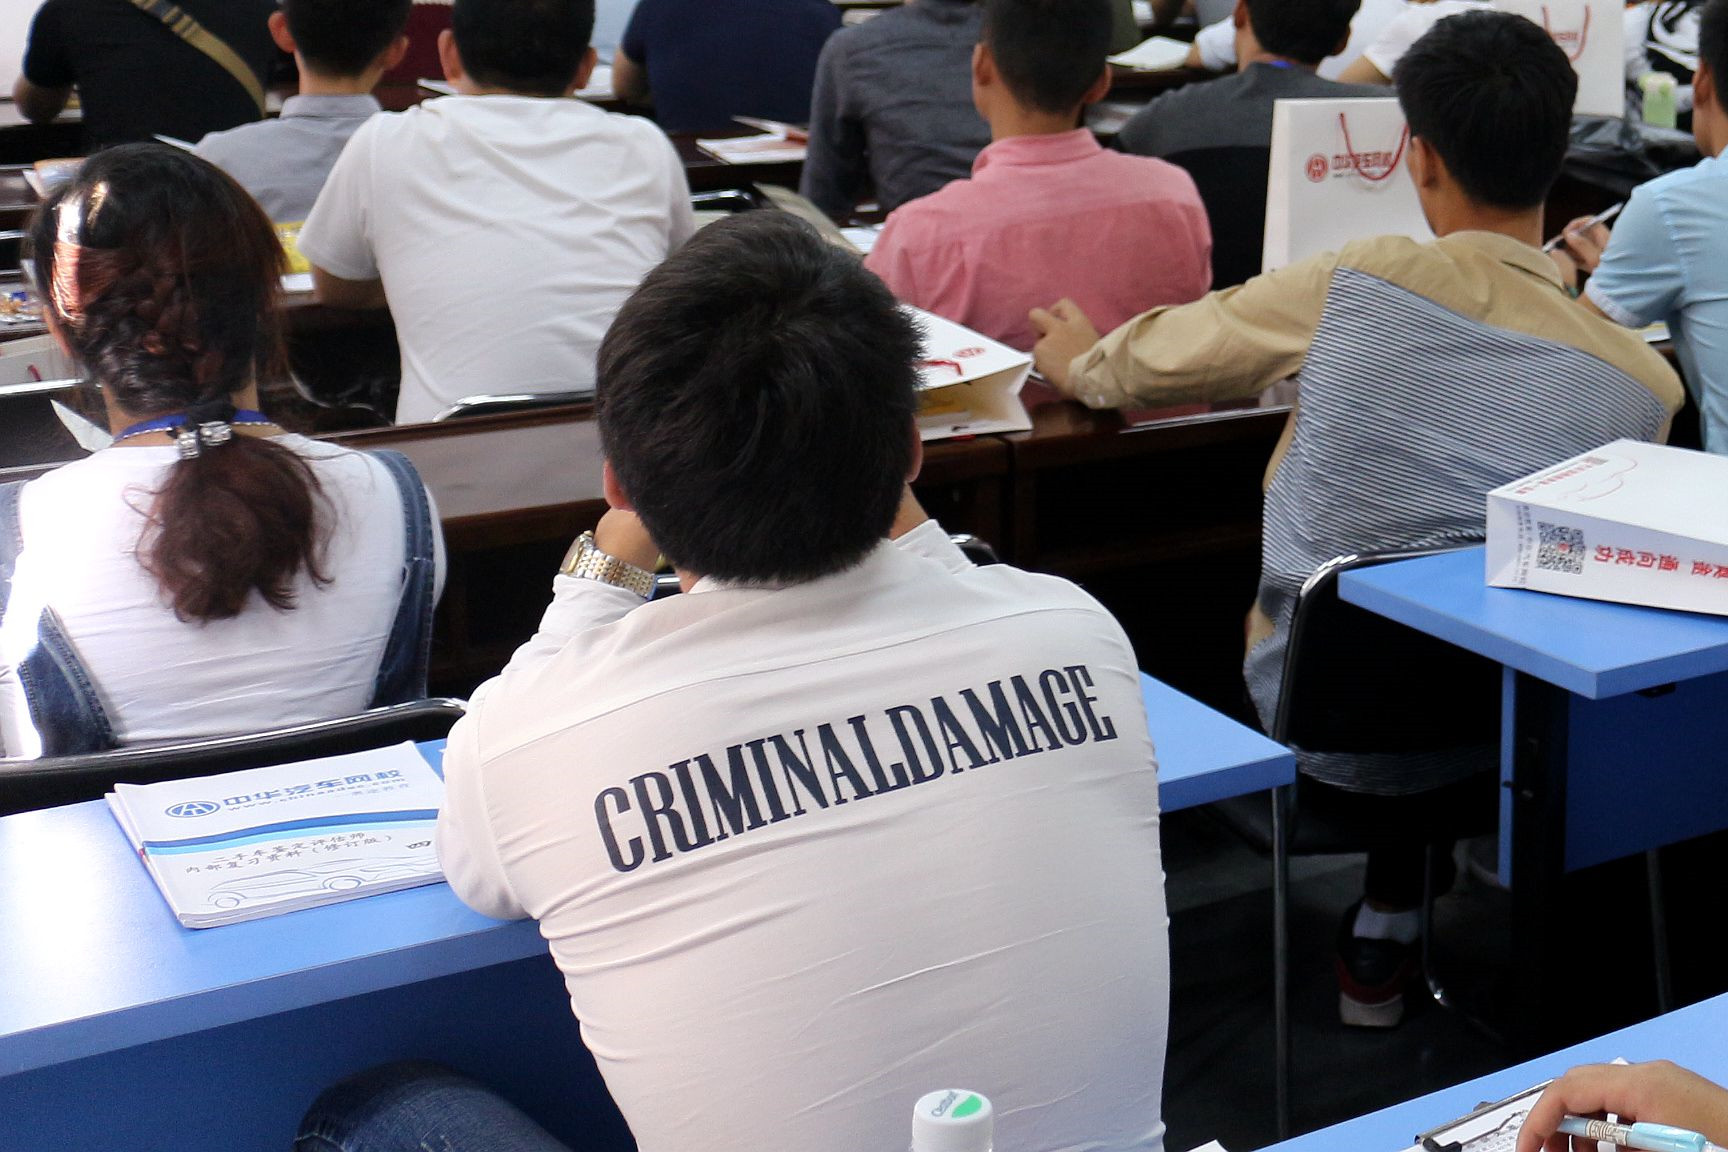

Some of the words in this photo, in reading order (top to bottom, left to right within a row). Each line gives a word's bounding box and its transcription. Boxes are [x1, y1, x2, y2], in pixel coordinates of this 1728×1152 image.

[1593, 543, 1682, 574] 通向成功
[593, 664, 1118, 873] CRIMINALDAMAGE
[223, 769, 404, 807] 中华汽车网校
[212, 831, 368, 864] 二手车鉴定评估师
